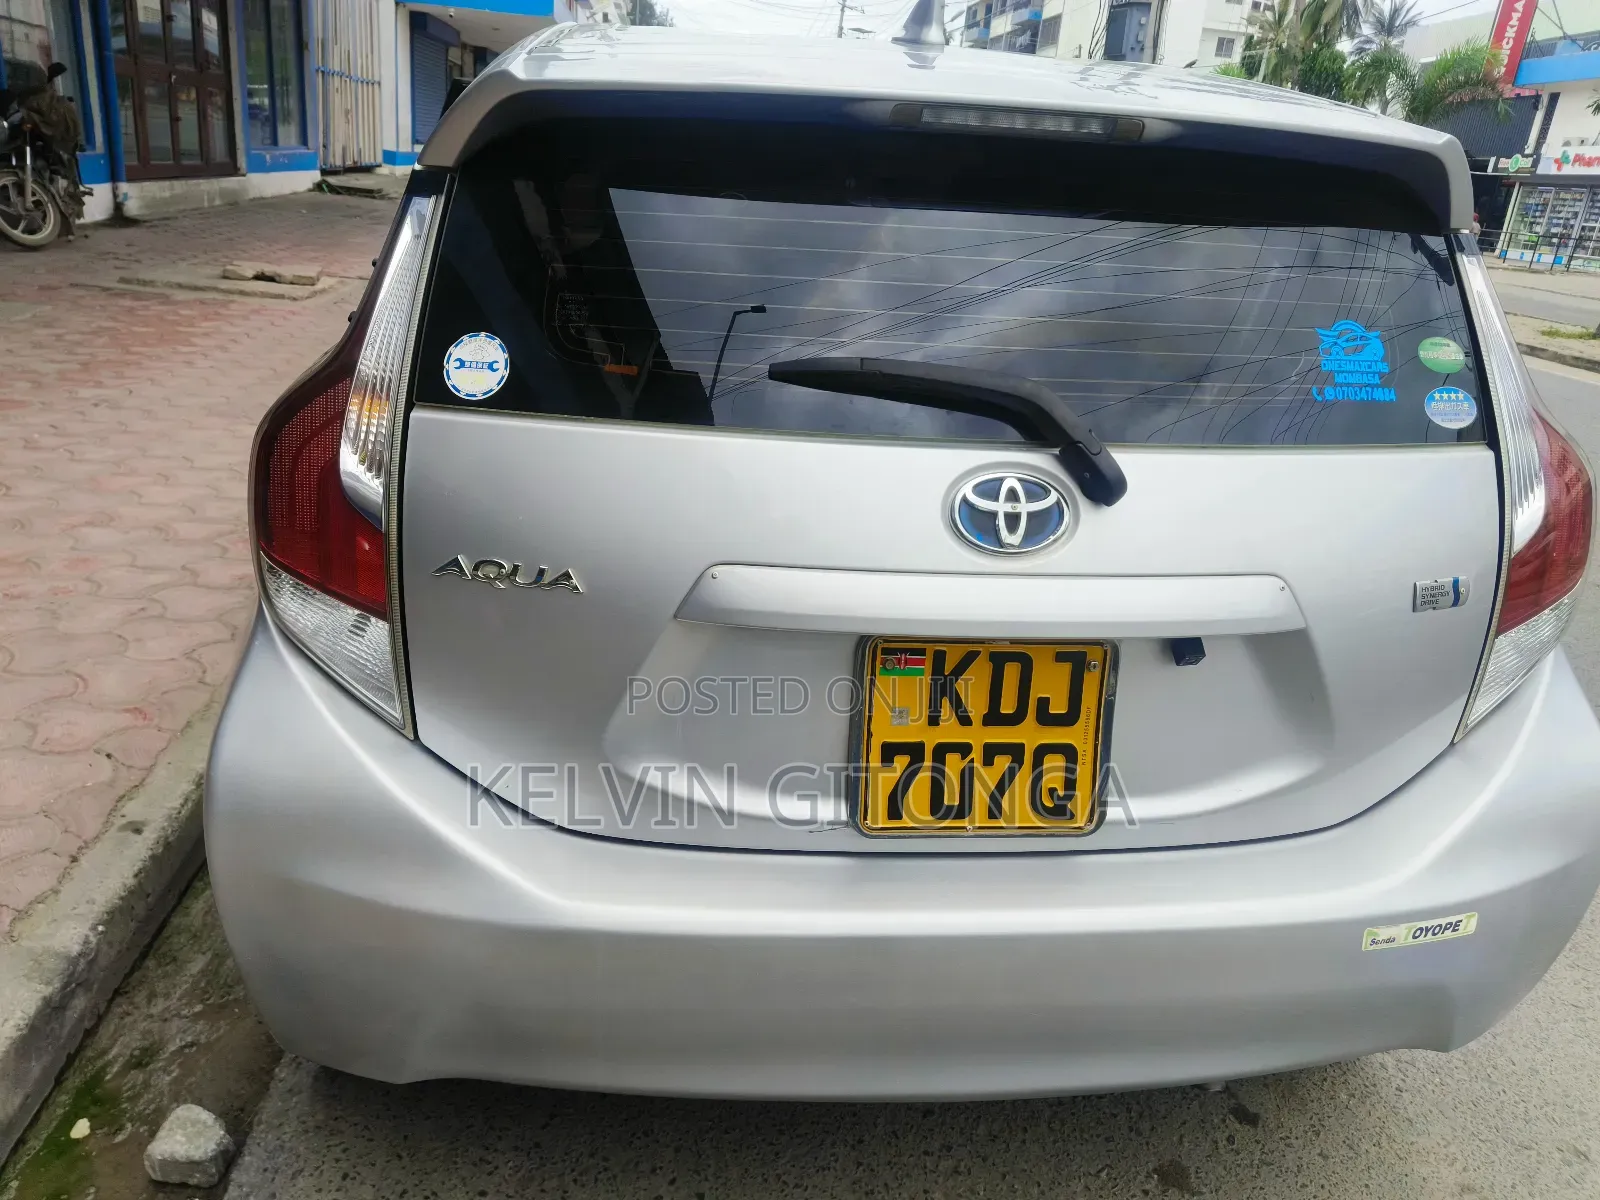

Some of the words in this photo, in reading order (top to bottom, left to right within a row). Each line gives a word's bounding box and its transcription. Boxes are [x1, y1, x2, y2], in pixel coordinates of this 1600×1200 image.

[1334, 373, 1380, 384] MOMBASA
[431, 554, 584, 594] AQUA
[1421, 584, 1446, 593] HYBRID
[1421, 591, 1450, 600] SYNERGY
[1420, 599, 1440, 607] DRIVE
[928, 649, 1088, 727] KDJ
[880, 741, 1079, 821] 707Q
